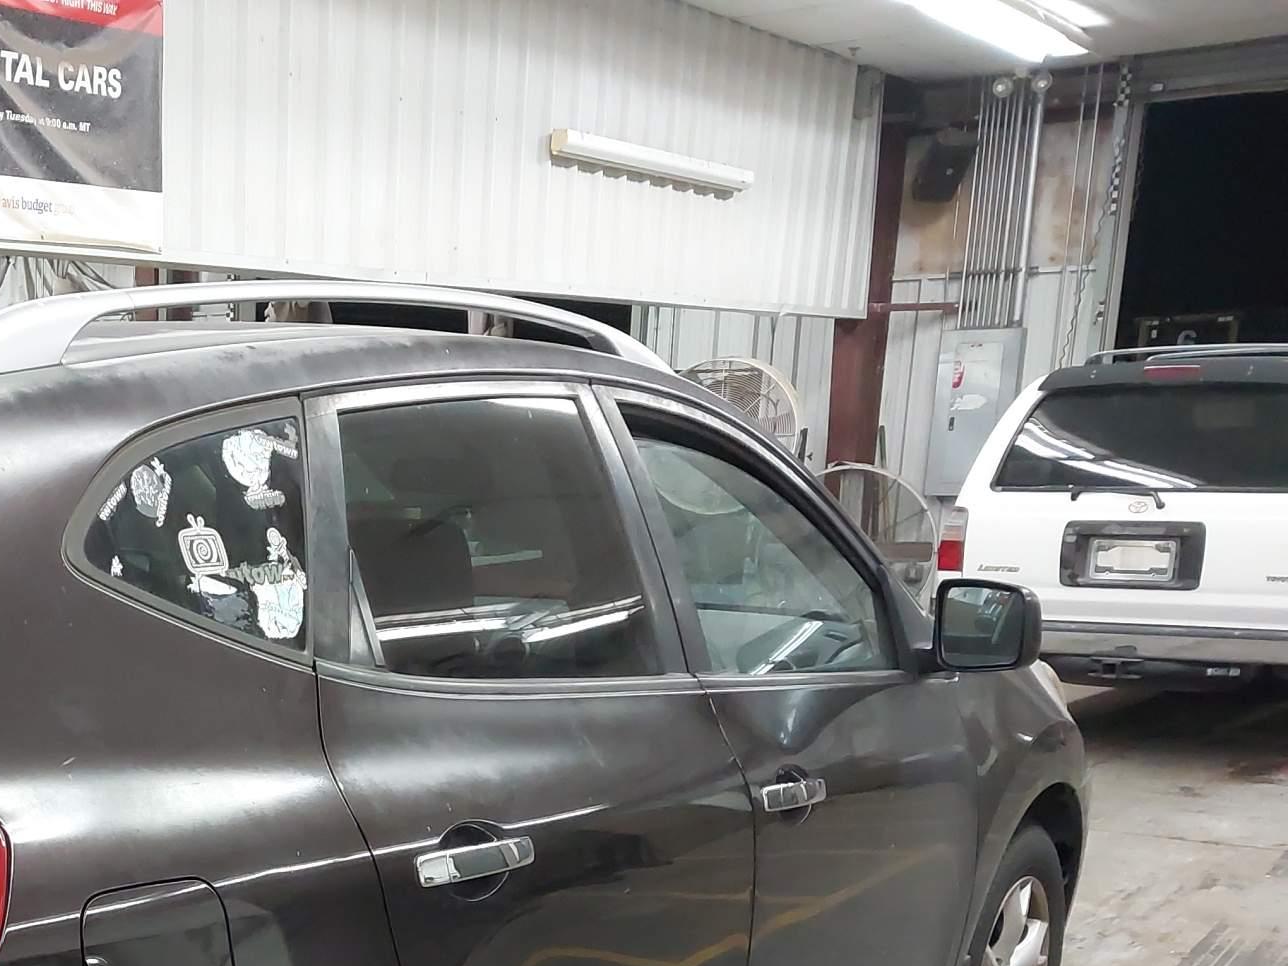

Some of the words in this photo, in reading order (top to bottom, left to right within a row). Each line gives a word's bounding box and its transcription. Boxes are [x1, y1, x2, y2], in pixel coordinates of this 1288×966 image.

[57, 60, 122, 99] CARS
[78, 121, 91, 132] MT
[2, 196, 20, 210] avis
[21, 196, 53, 215] budget
